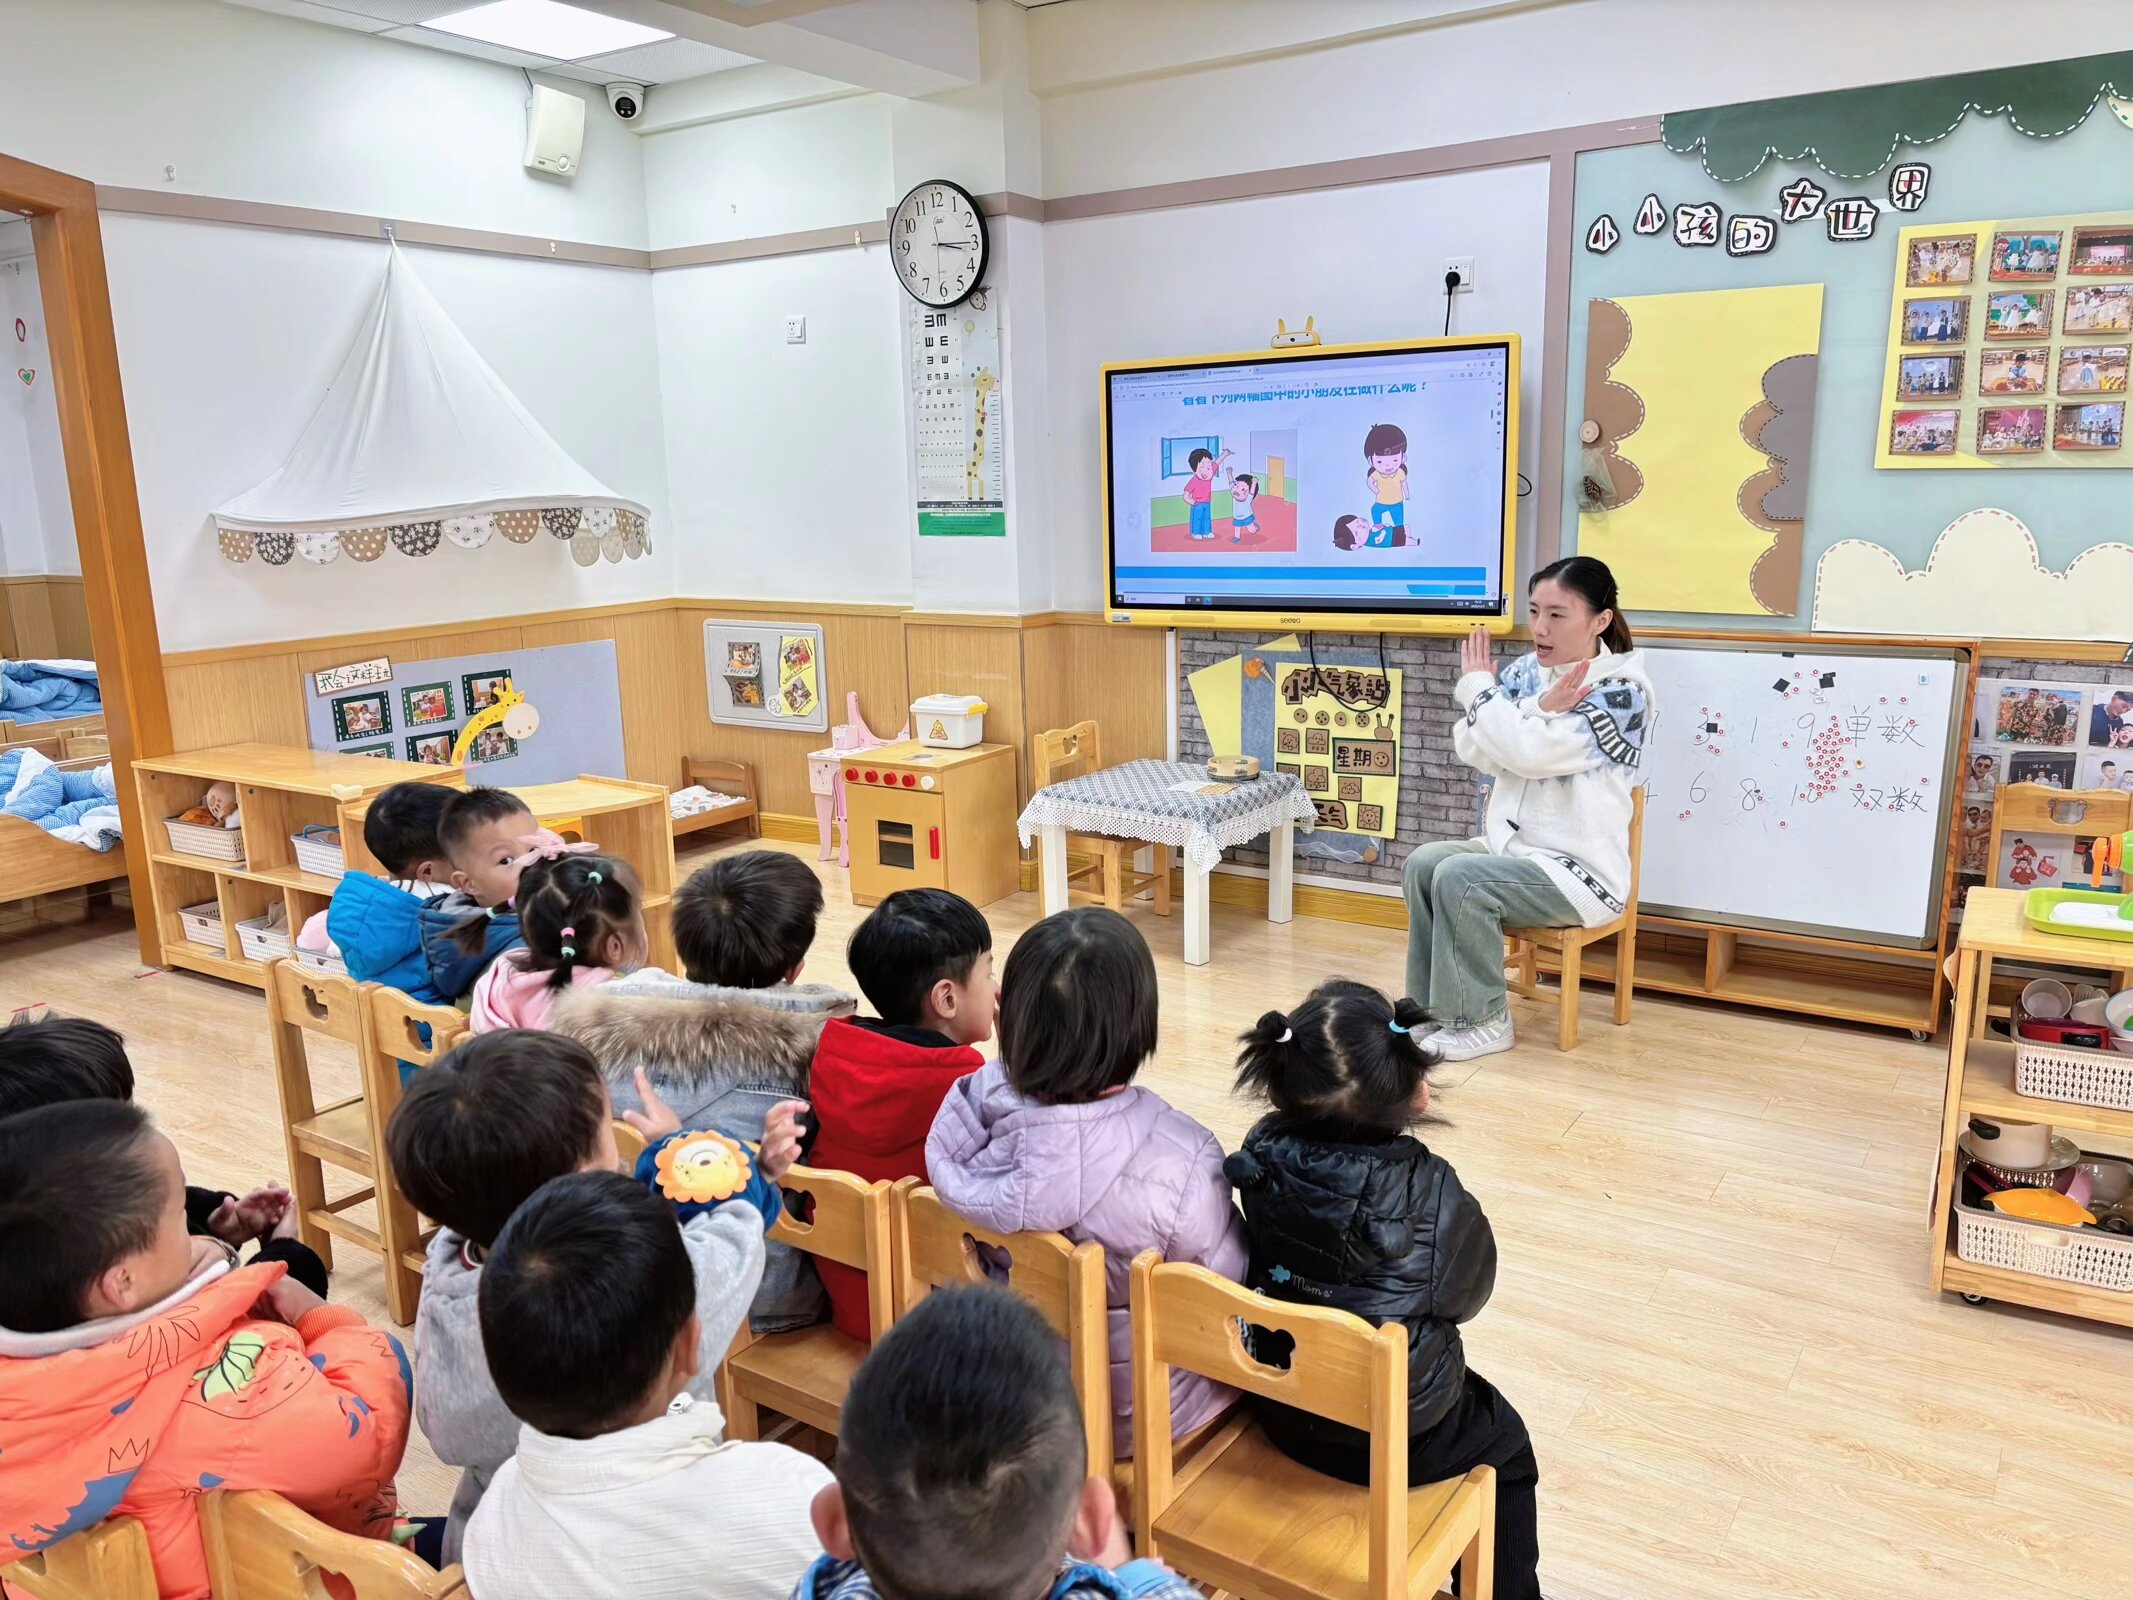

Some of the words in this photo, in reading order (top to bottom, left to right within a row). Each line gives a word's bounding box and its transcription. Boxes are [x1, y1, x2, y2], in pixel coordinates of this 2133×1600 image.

[930, 191, 944, 208] 12
[952, 196, 958, 212] 1
[915, 200, 926, 217] 11
[1592, 169, 1926, 251] 小小孩的大世界
[904, 217, 917, 234] 10
[963, 211, 974, 228] 2
[902, 239, 911, 256] 9
[970, 233, 979, 250] 3
[909, 261, 918, 278] 8
[966, 257, 976, 273] 4
[922, 277, 930, 293] 7
[939, 281, 948, 298] 6
[956, 275, 965, 291] 5
[1692, 710, 1711, 746] 3
[1796, 712, 1816, 748] 9
[1845, 704, 1926, 748] 单数
[1337, 746, 1372, 768] 星期
[1689, 770, 1707, 803] 6
[1739, 778, 1756, 811] 8
[1849, 785, 1928, 813] 双数
